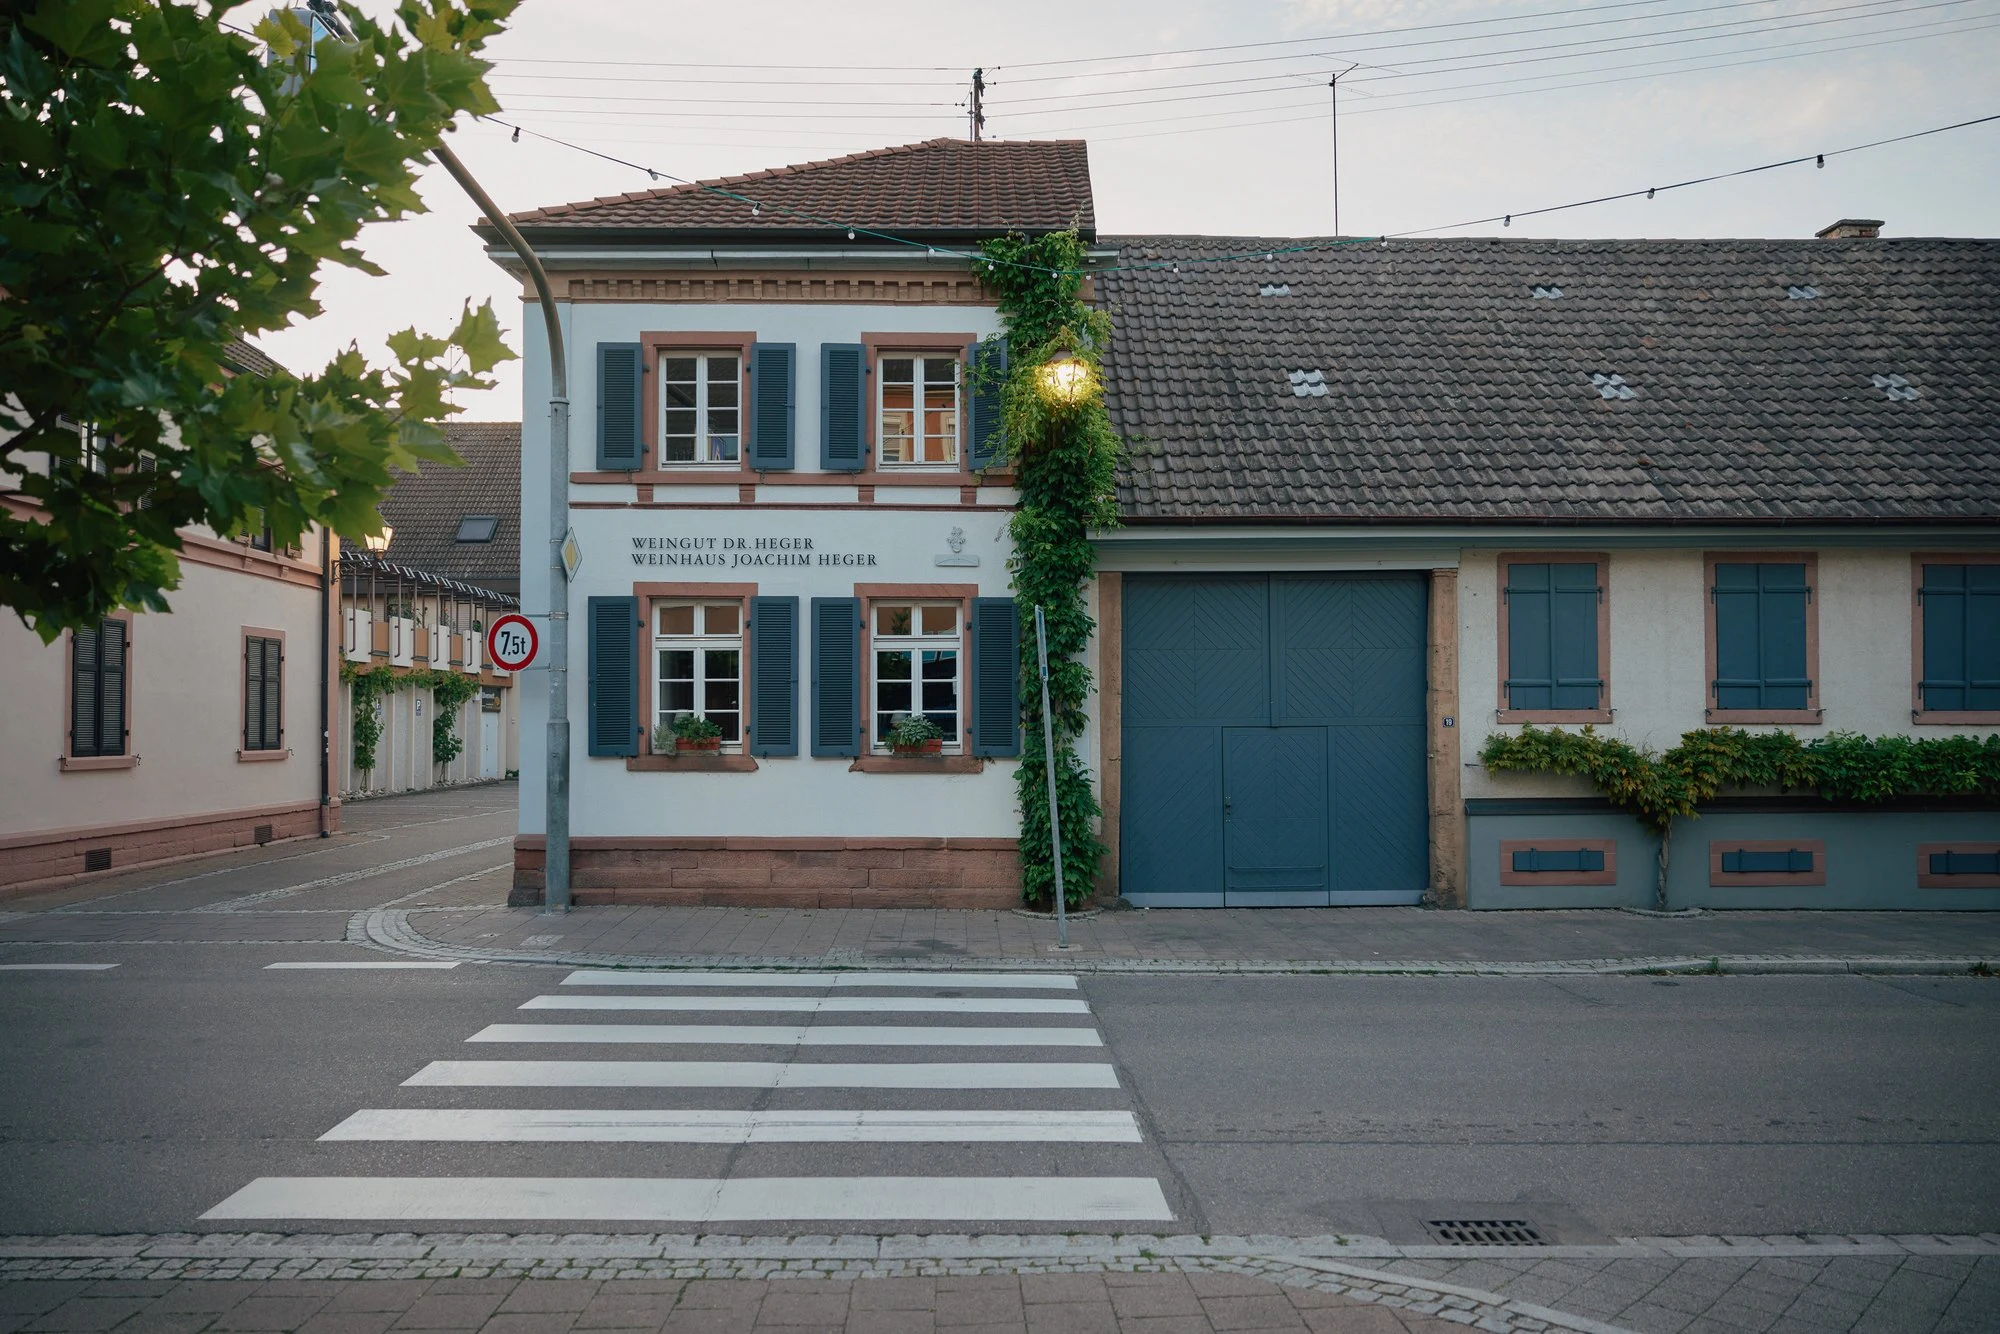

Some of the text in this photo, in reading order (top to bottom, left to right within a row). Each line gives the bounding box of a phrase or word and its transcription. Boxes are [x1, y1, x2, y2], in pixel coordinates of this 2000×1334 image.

[632, 538, 717, 549] WEINGUT
[755, 538, 814, 549] HEGER
[631, 554, 878, 568] WEINHAUS JOACHIM HEGER
[501, 631, 526, 656] 7,5t
